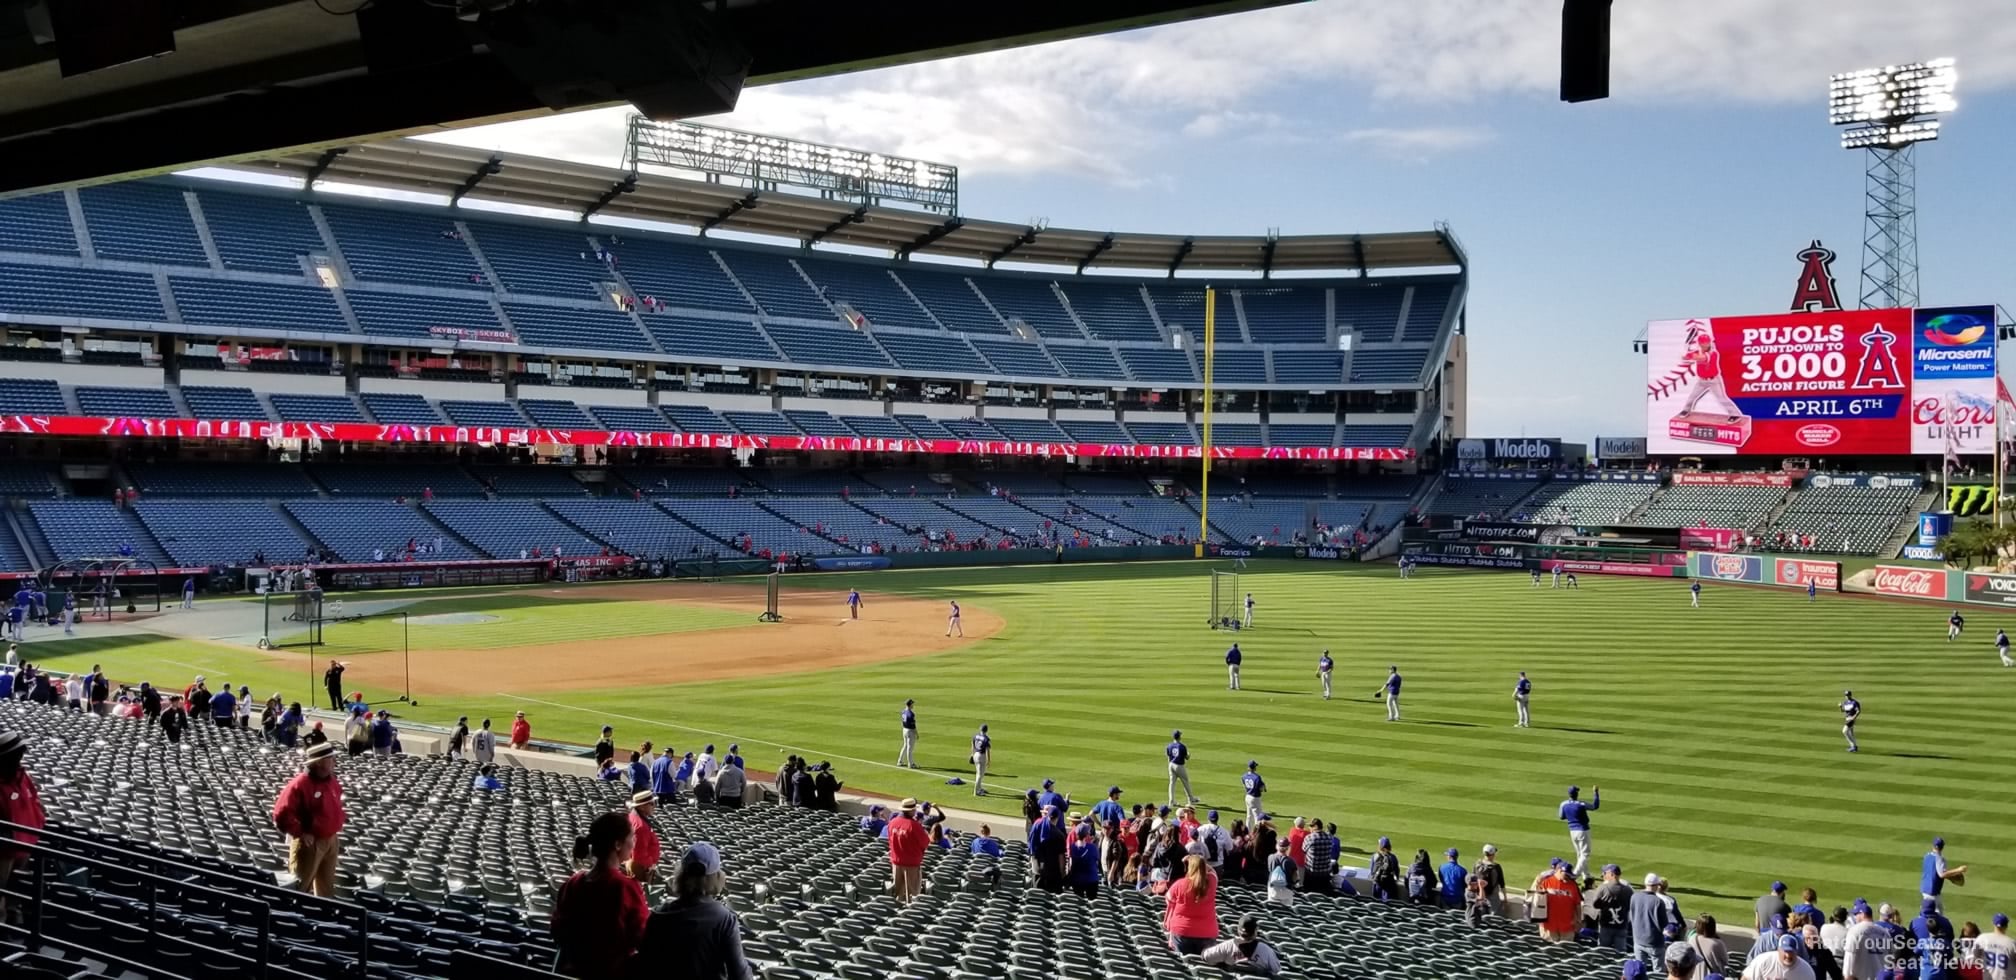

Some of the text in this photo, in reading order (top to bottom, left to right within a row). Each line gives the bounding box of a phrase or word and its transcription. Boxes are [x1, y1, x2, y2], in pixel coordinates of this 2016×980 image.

[431, 326, 463, 335] SKYBOX
[1742, 324, 1844, 345] PUJOLS
[1743, 342, 1844, 354] COUNTDOWN TO
[1741, 351, 1846, 381] 3,000
[1741, 380, 1846, 392] ACTION FIGURE
[1776, 400, 1843, 416] APRIL
[1717, 429, 1740, 441] HITS
[1495, 439, 1550, 458] Modelo
[1605, 440, 1640, 454] Modelo
[1308, 549, 1337, 558] Modelo
